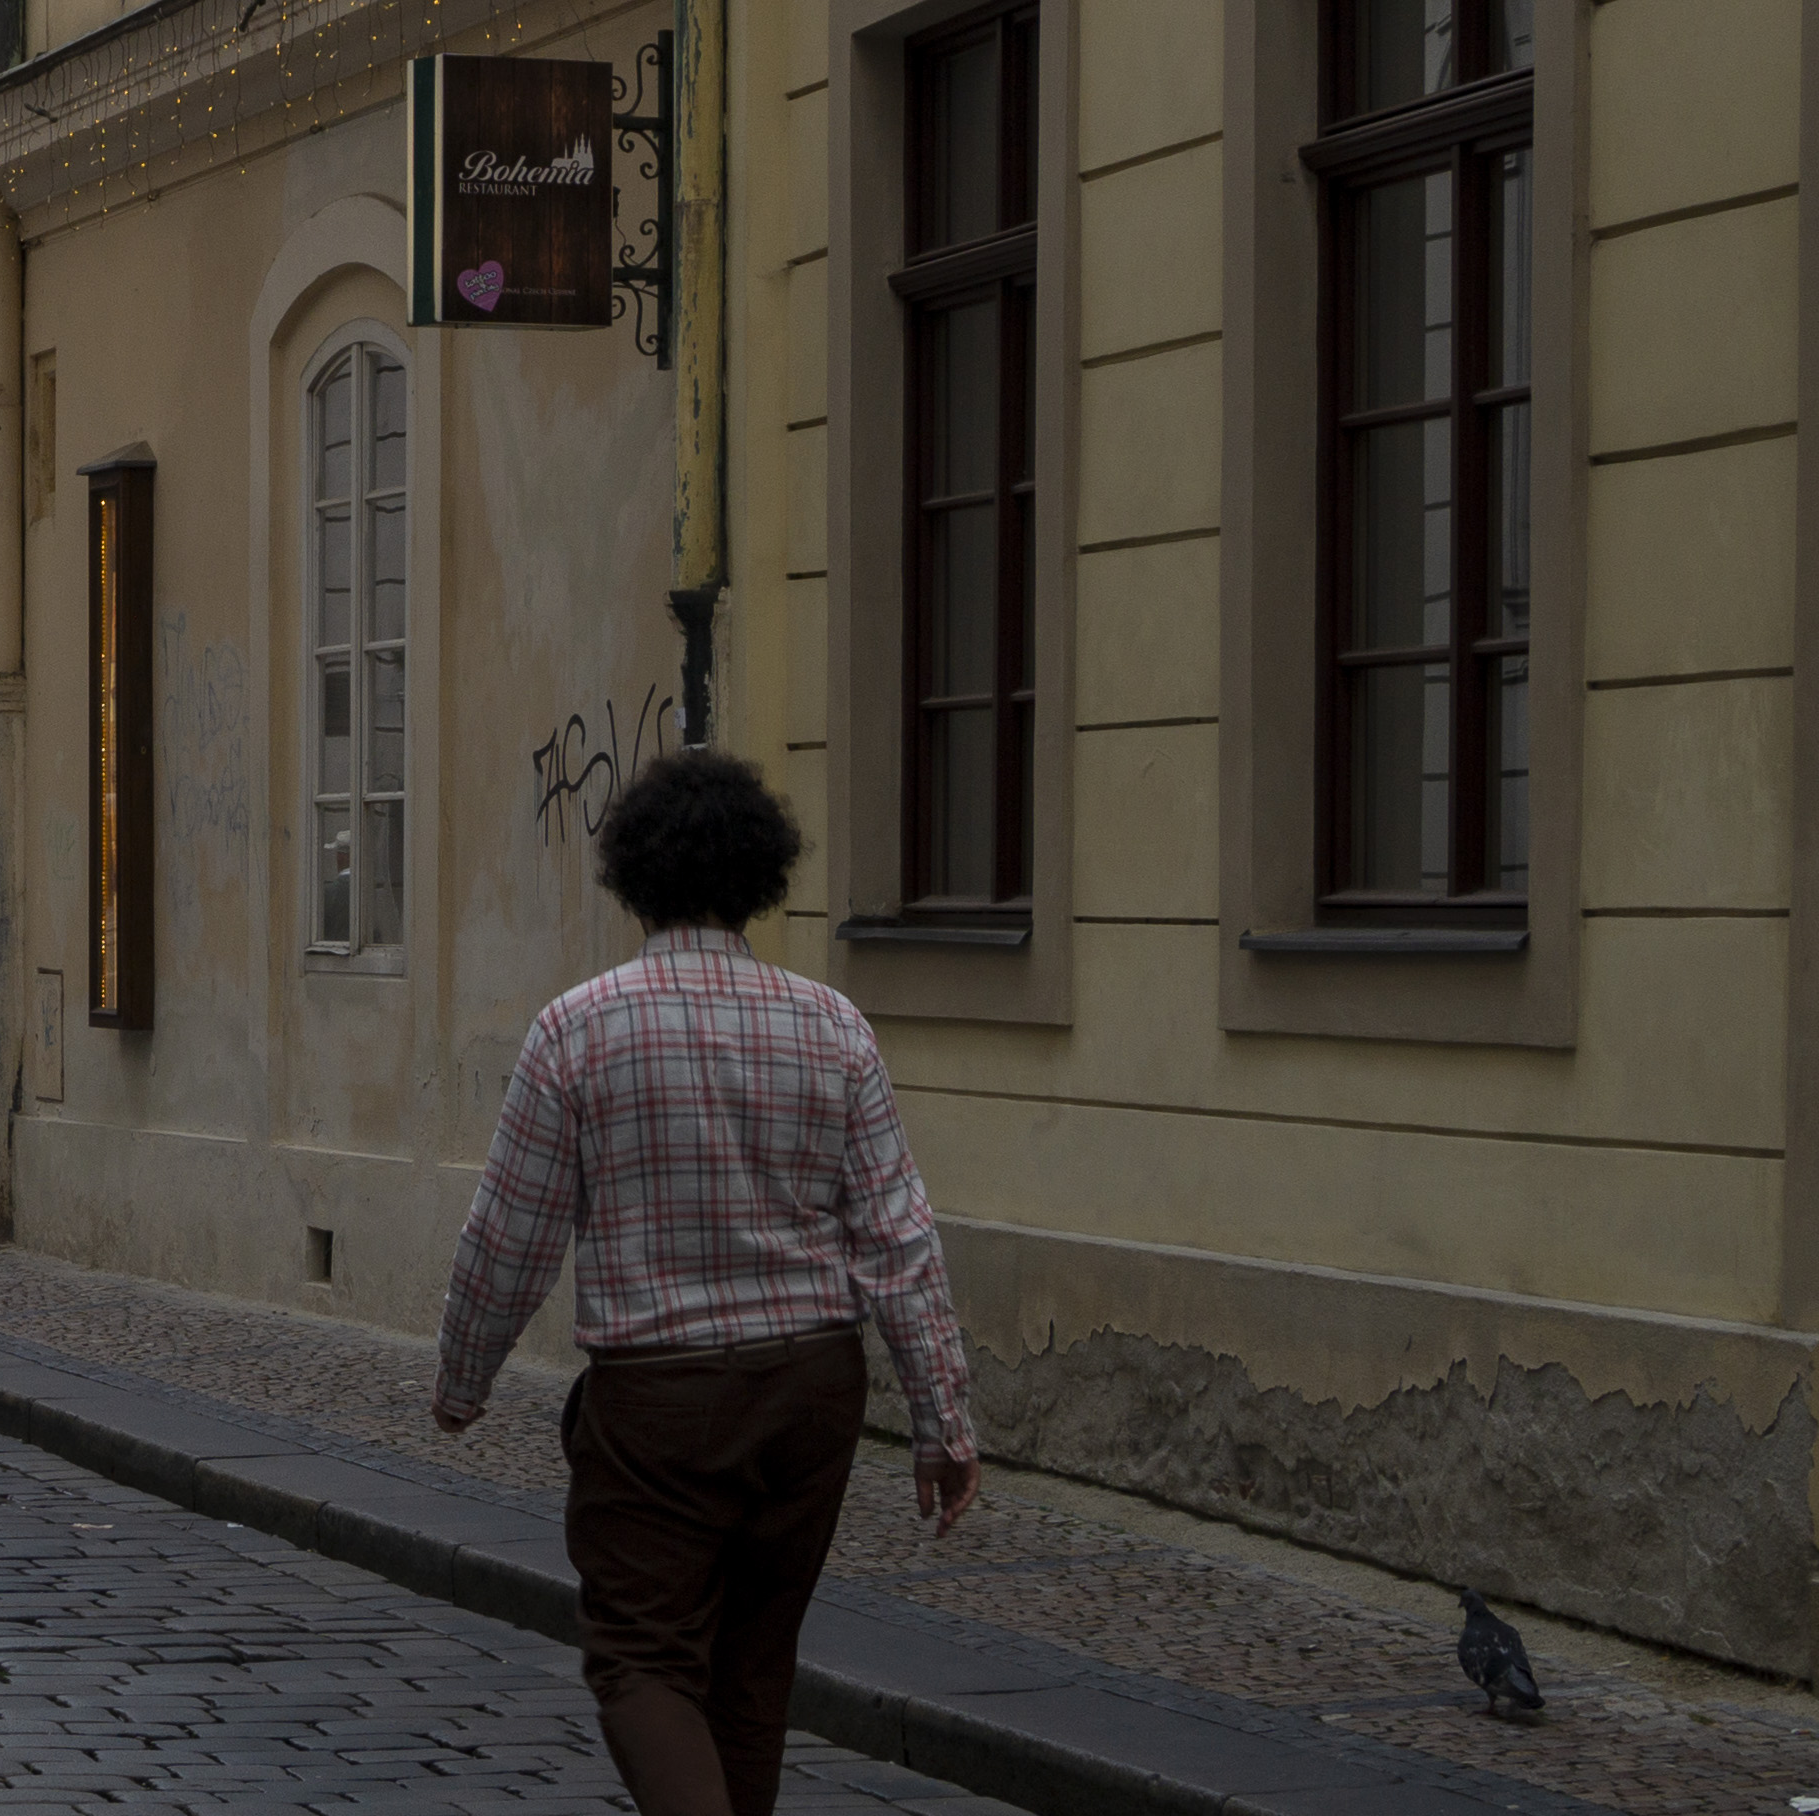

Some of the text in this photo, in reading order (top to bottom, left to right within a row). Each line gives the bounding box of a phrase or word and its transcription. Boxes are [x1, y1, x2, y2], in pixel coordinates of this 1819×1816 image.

[459, 150, 594, 185] Bohemia
[459, 183, 538, 196] RESTAURANT
[464, 271, 497, 289] tattoo
